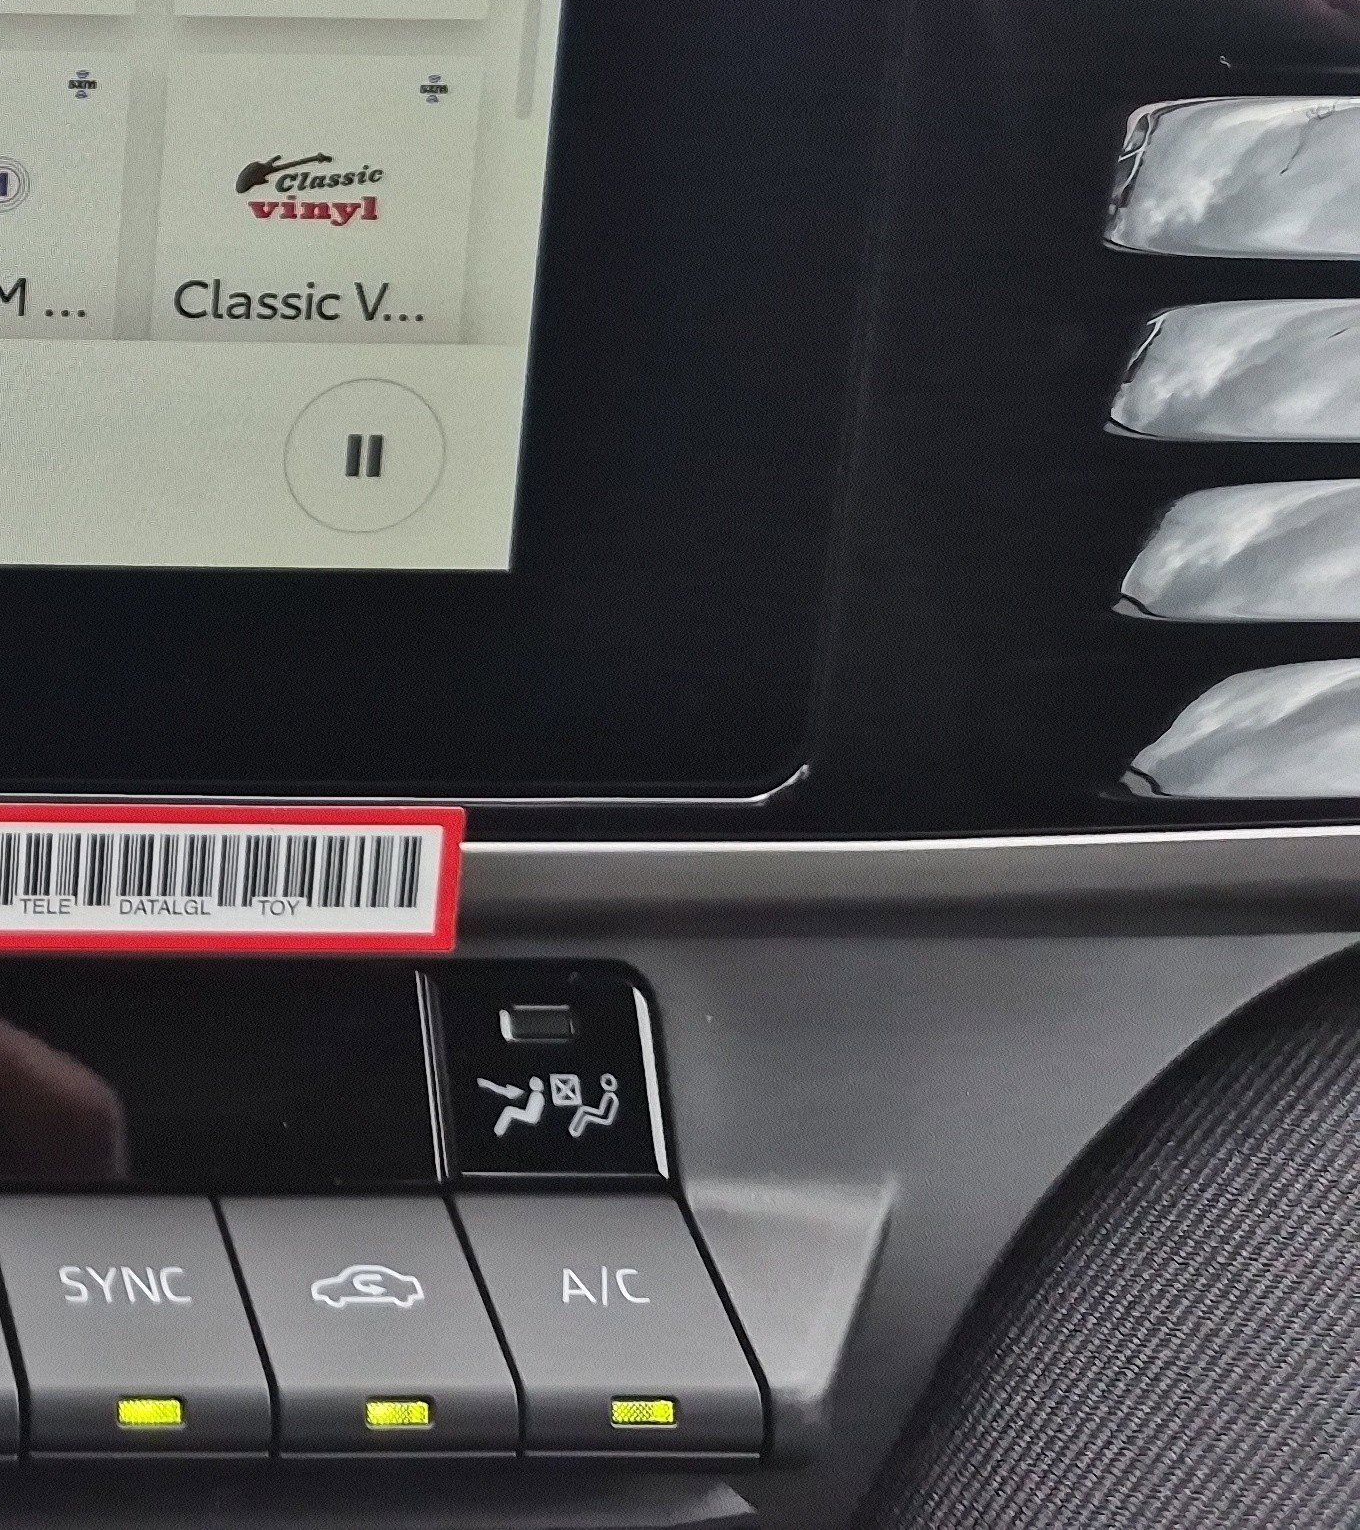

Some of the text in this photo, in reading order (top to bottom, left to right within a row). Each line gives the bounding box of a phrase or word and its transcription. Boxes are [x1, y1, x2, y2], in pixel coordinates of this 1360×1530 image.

[274, 164, 384, 193] Classic
[247, 194, 378, 227] vinyl
[174, 279, 424, 322] Classic V...
[20, 897, 301, 917] TELE DATALGL TOY
[59, 1266, 191, 1304] SYNC
[561, 1266, 651, 1305] A/C
